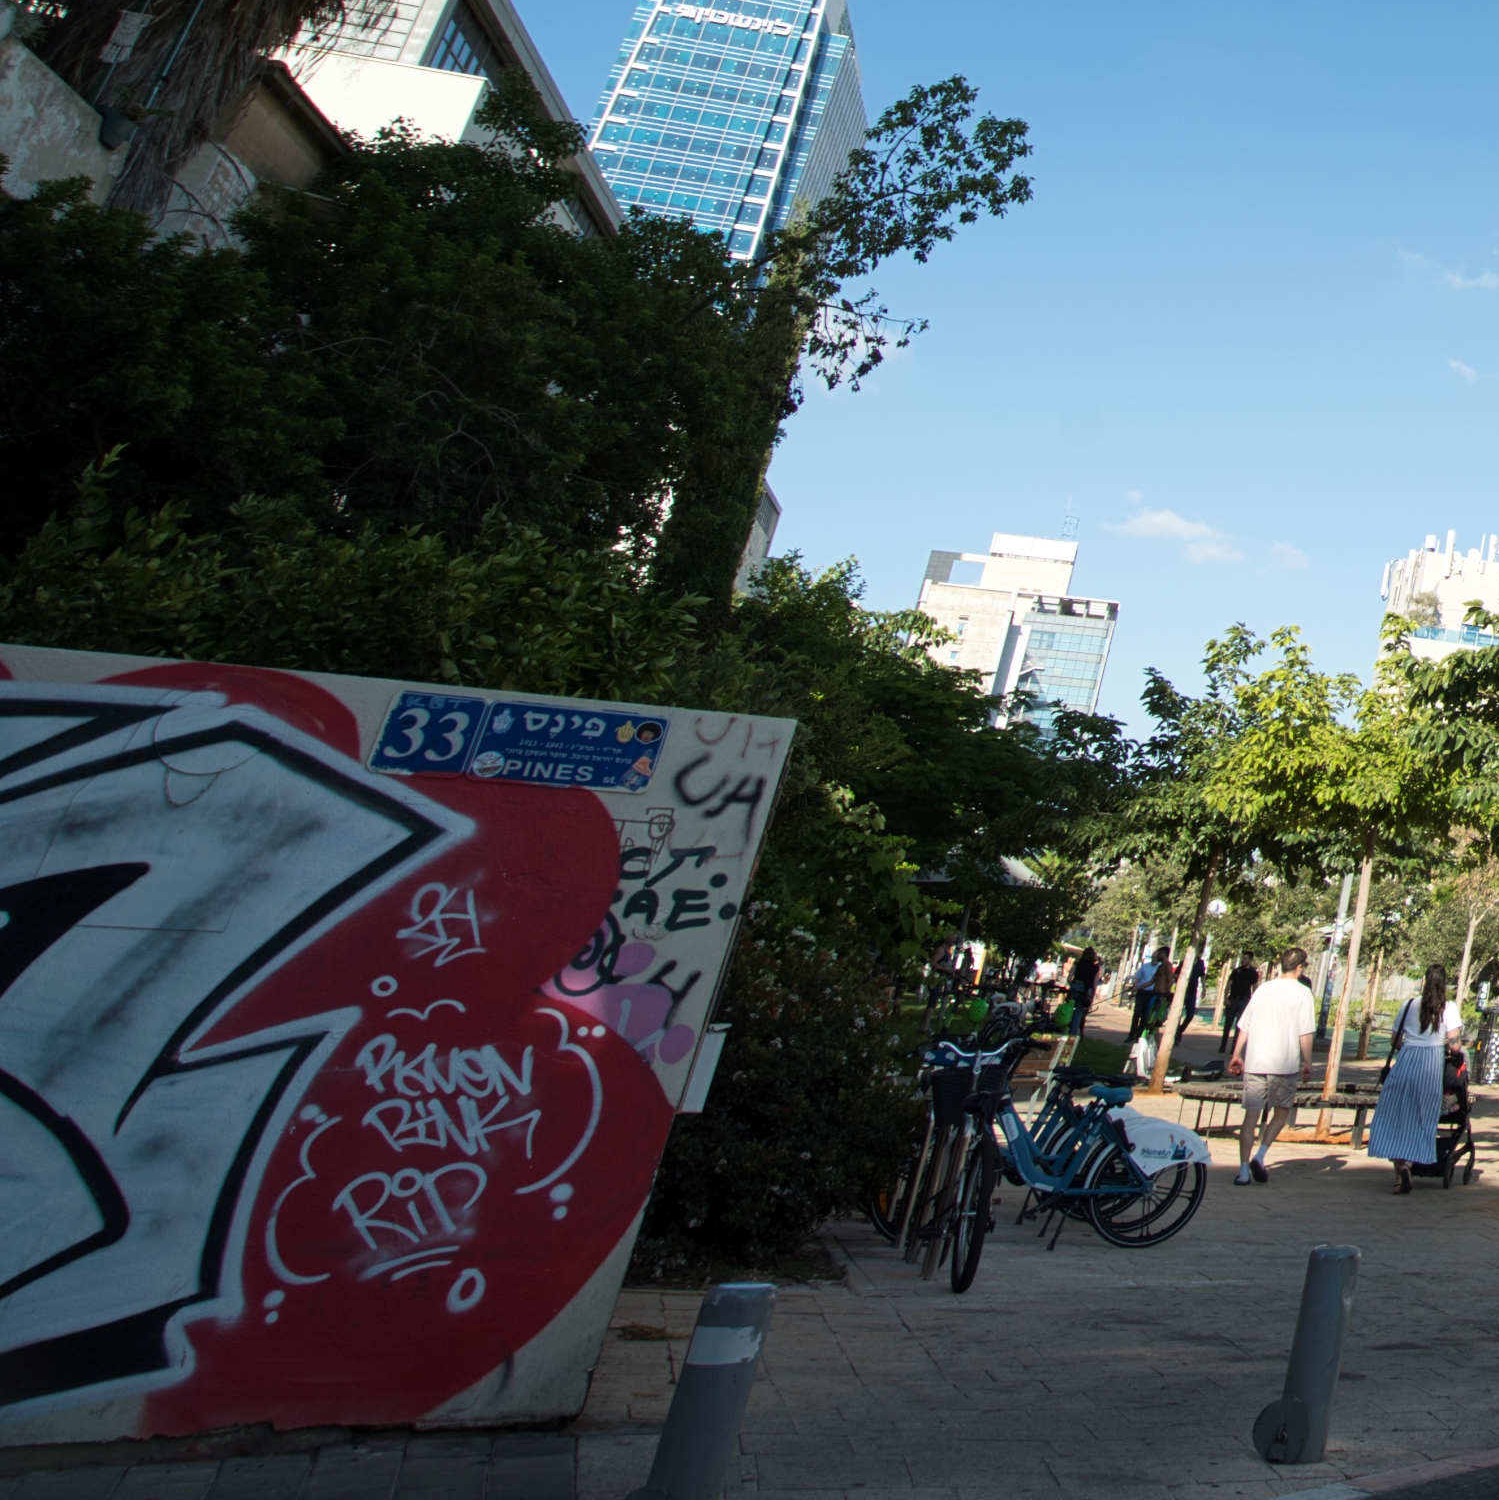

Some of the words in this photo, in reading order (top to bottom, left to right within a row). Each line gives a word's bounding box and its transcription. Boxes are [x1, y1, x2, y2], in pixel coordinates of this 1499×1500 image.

[384, 708, 470, 761] 33
[502, 760, 594, 782] PINES
[602, 775, 617, 784] st.
